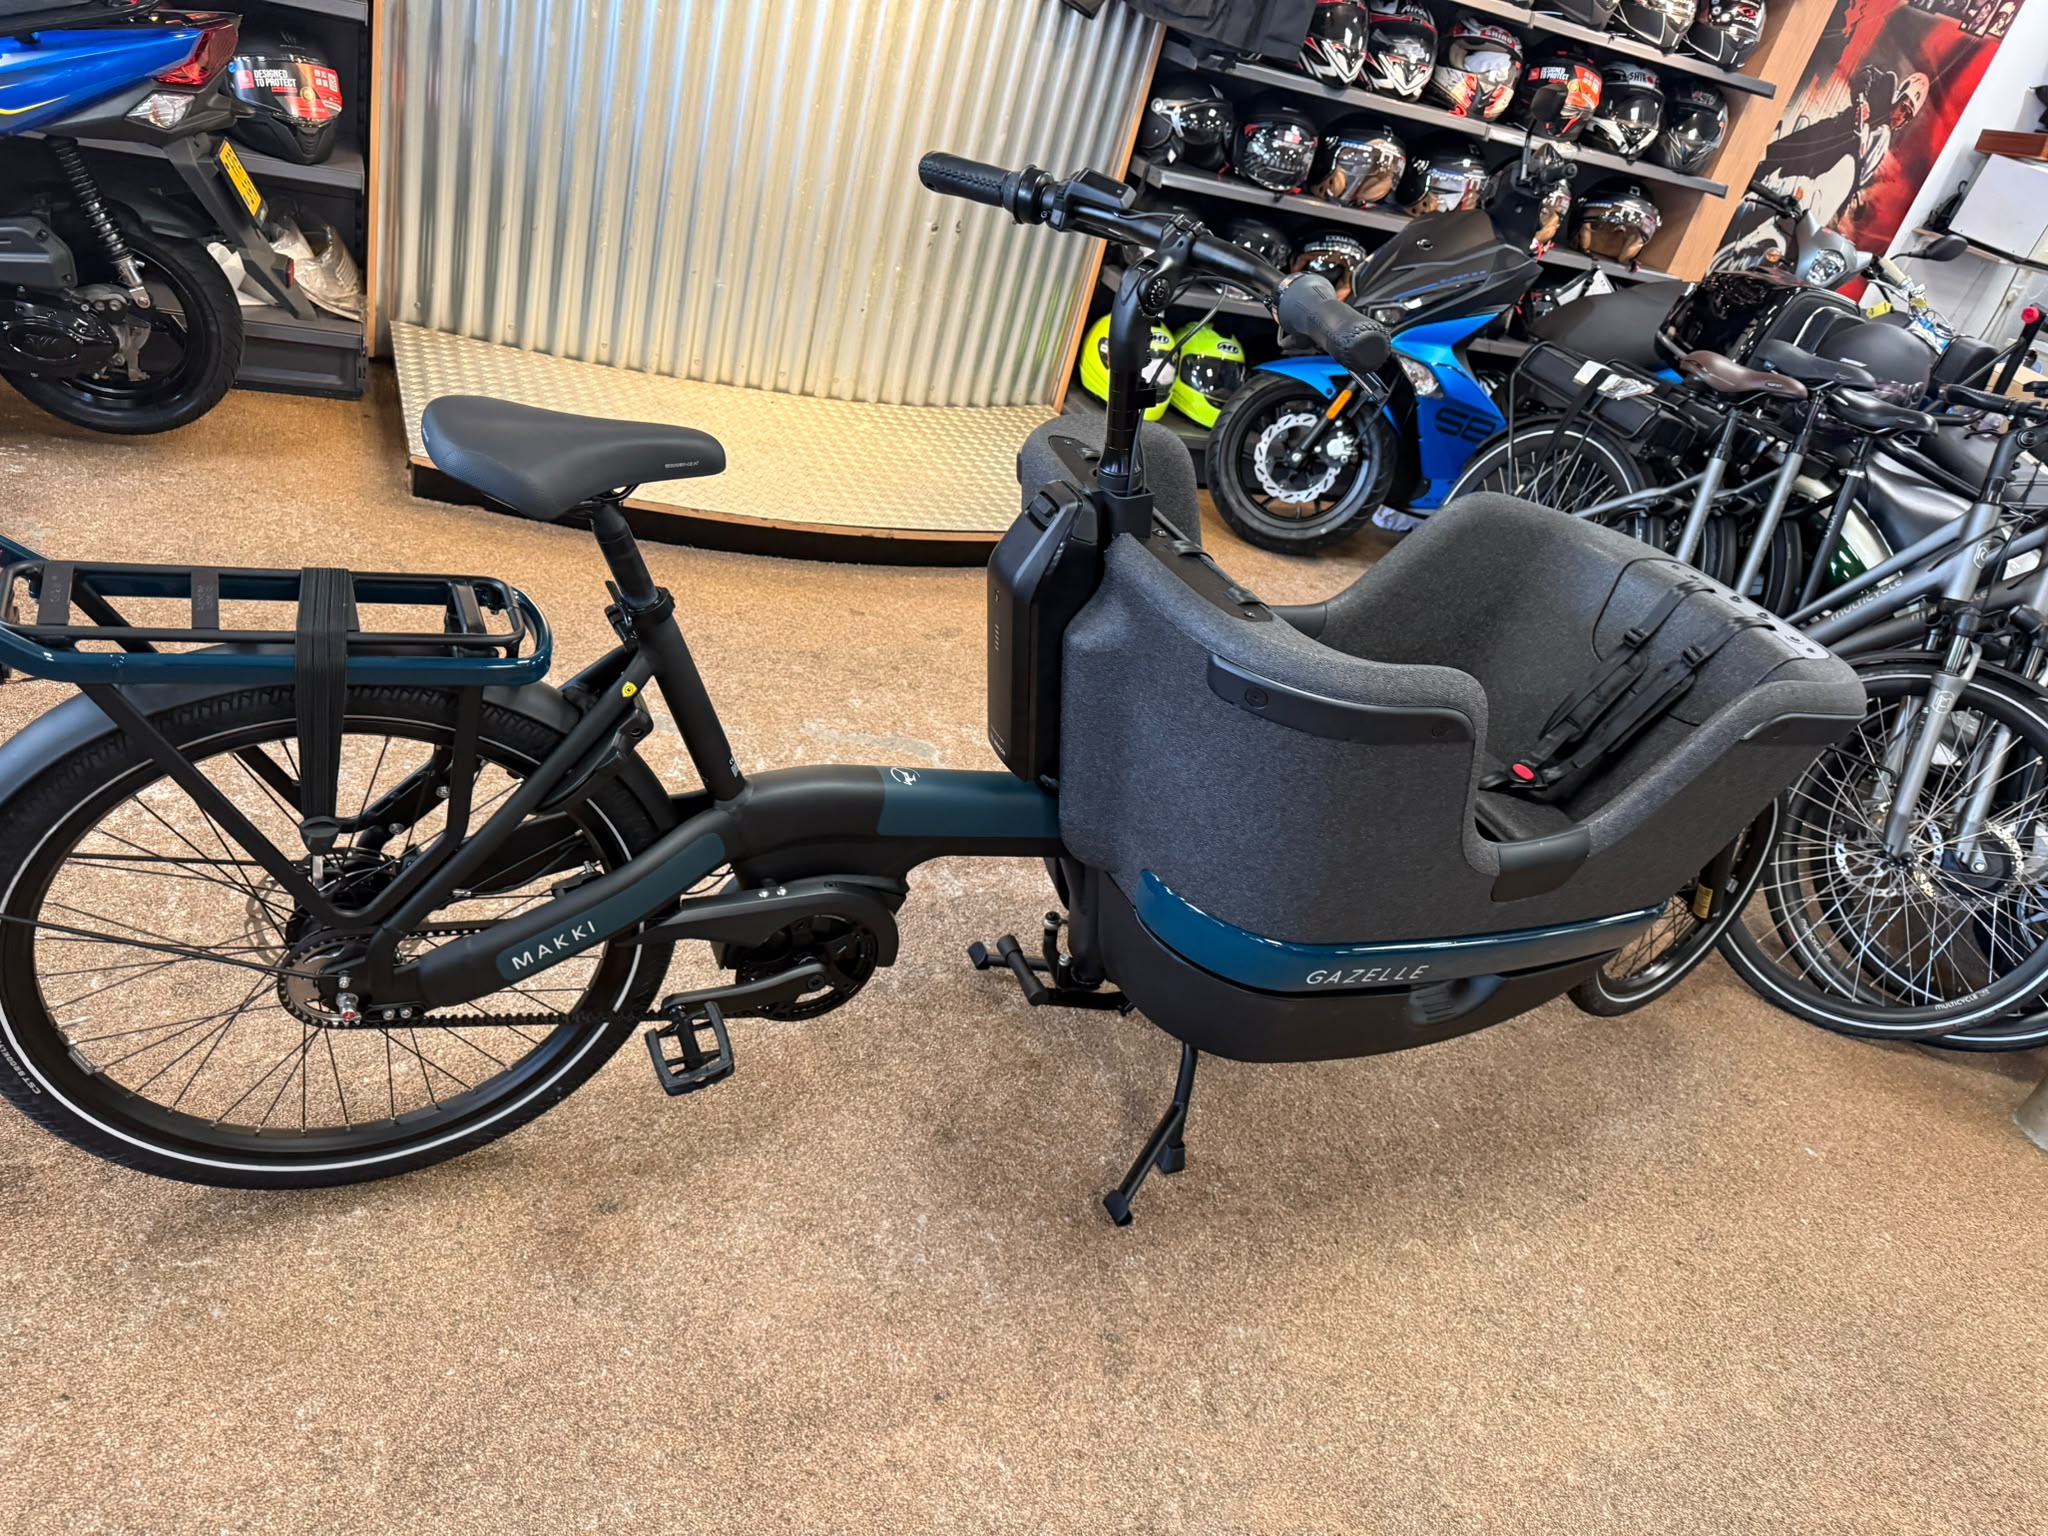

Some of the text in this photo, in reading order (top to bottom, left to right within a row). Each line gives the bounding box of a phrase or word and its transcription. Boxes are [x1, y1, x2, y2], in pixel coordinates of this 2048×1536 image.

[253, 69, 288, 79] DESIGNED
[255, 78, 297, 88] TO PROTECT
[511, 920, 596, 970] MAKKI
[1306, 964, 1430, 985] GAZELLE
[22, 1076, 42, 1095] CST
